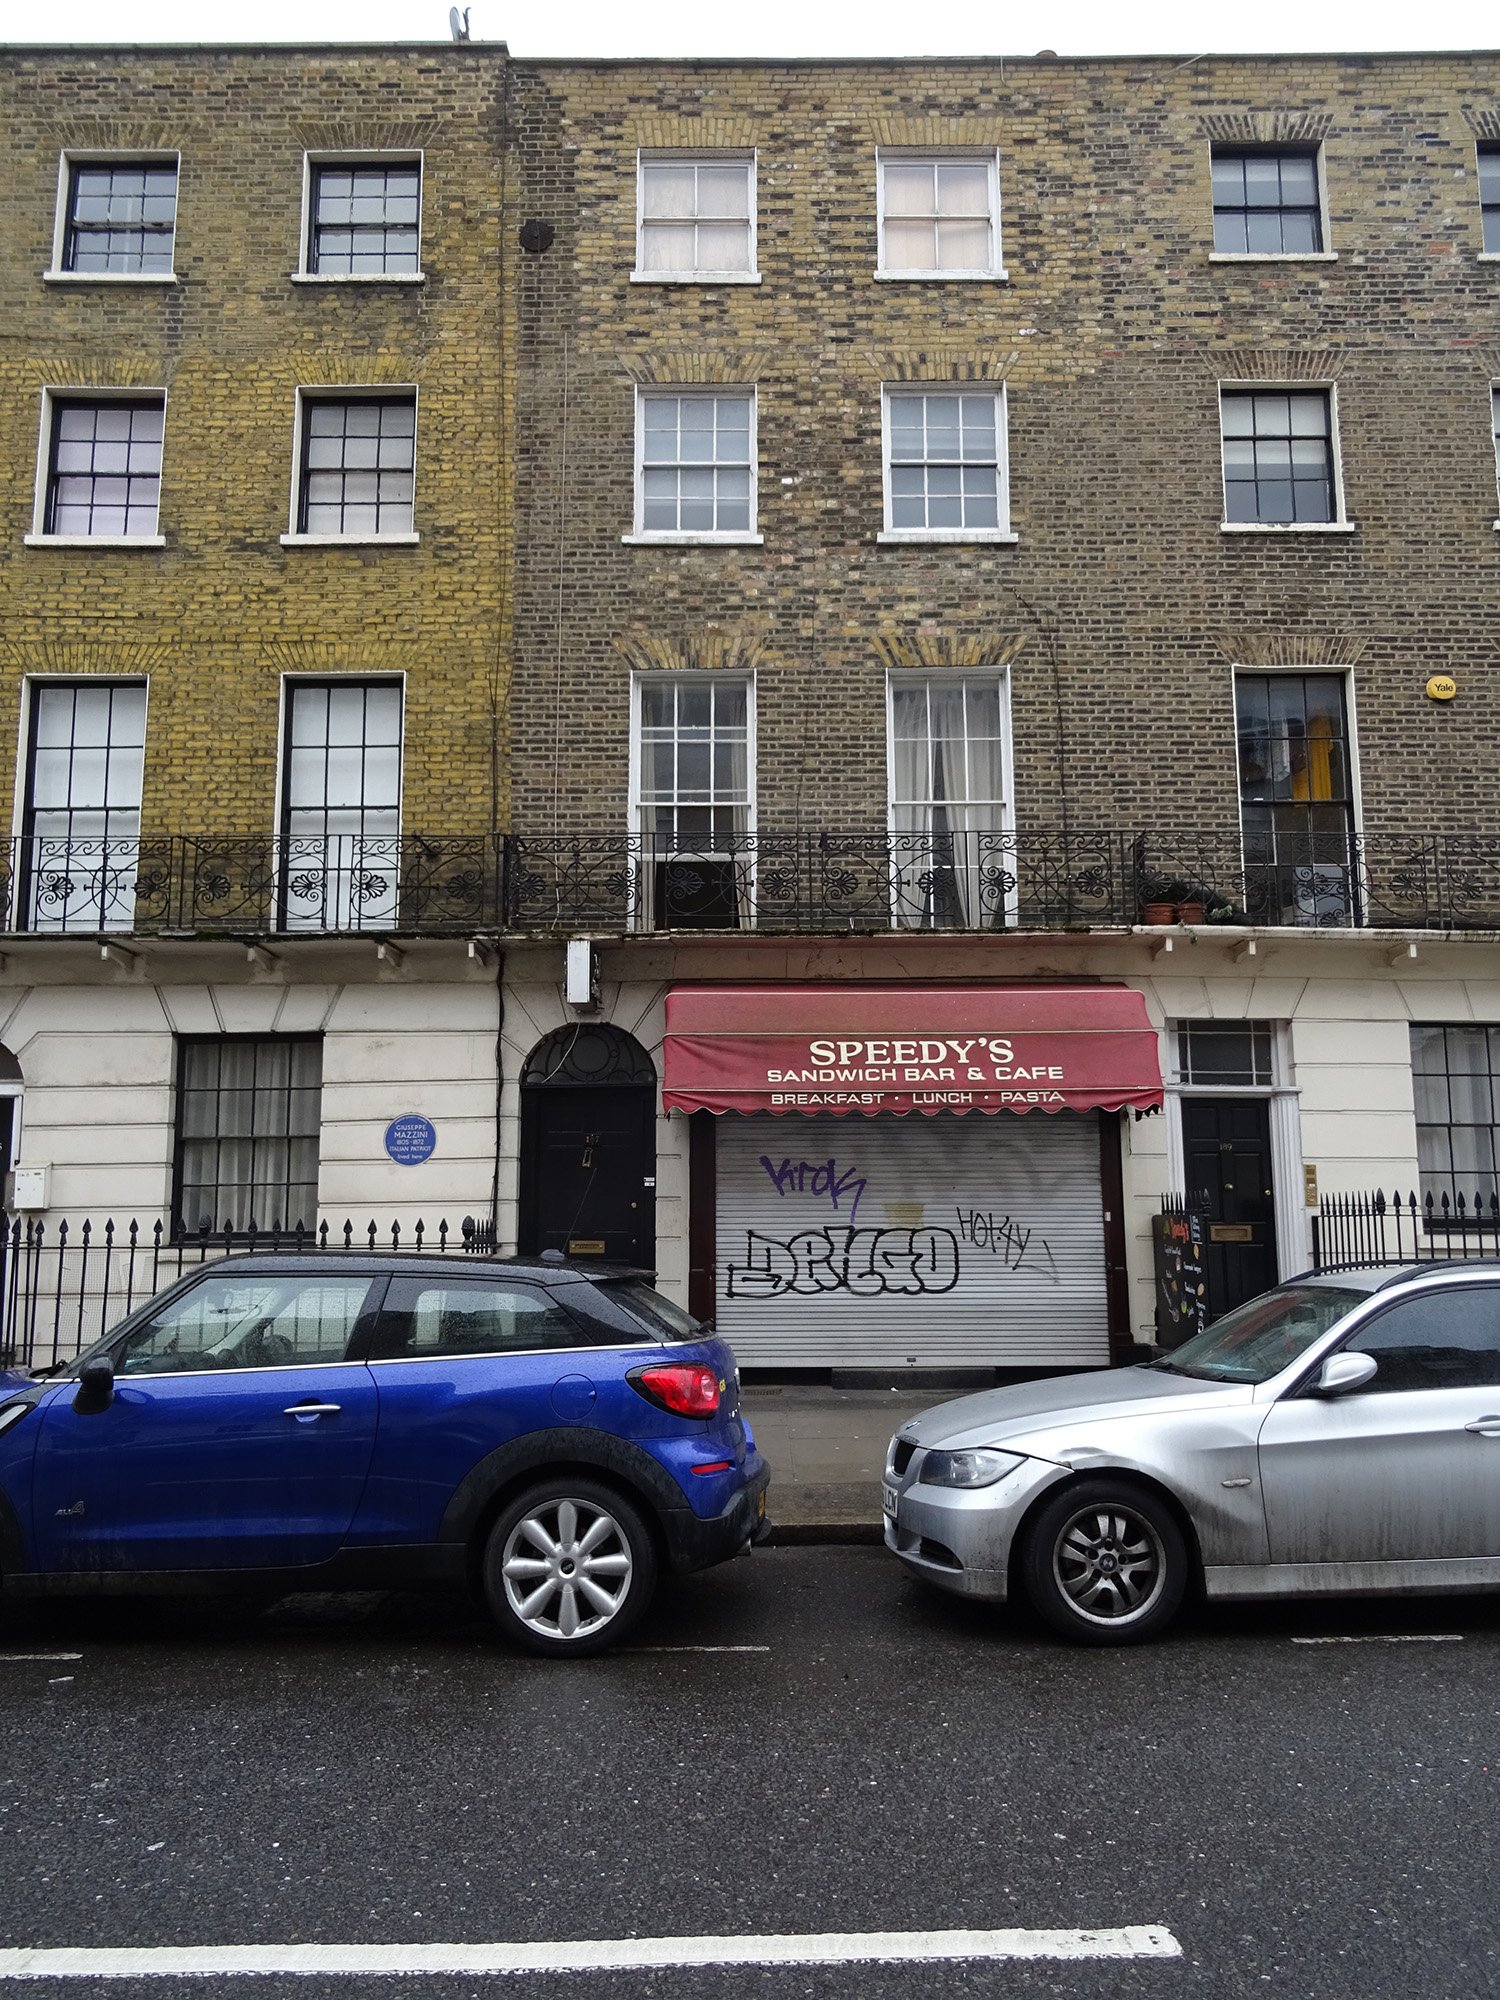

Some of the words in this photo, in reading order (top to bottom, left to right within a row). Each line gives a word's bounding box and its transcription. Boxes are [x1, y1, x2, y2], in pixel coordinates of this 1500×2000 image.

[1434, 683, 1454, 692] Yale
[809, 1037, 1015, 1066] SPEEDY'S
[767, 1069, 897, 1082] SANDWICH
[904, 1067, 956, 1081] BAR
[967, 1067, 987, 1080] &
[994, 1066, 1064, 1080] CAFE
[771, 1093, 885, 1105] BREAKFAST
[912, 1092, 973, 1104] LUNCH
[1001, 1091, 1066, 1103] PASTA
[393, 1131, 428, 1139] MAZZINI
